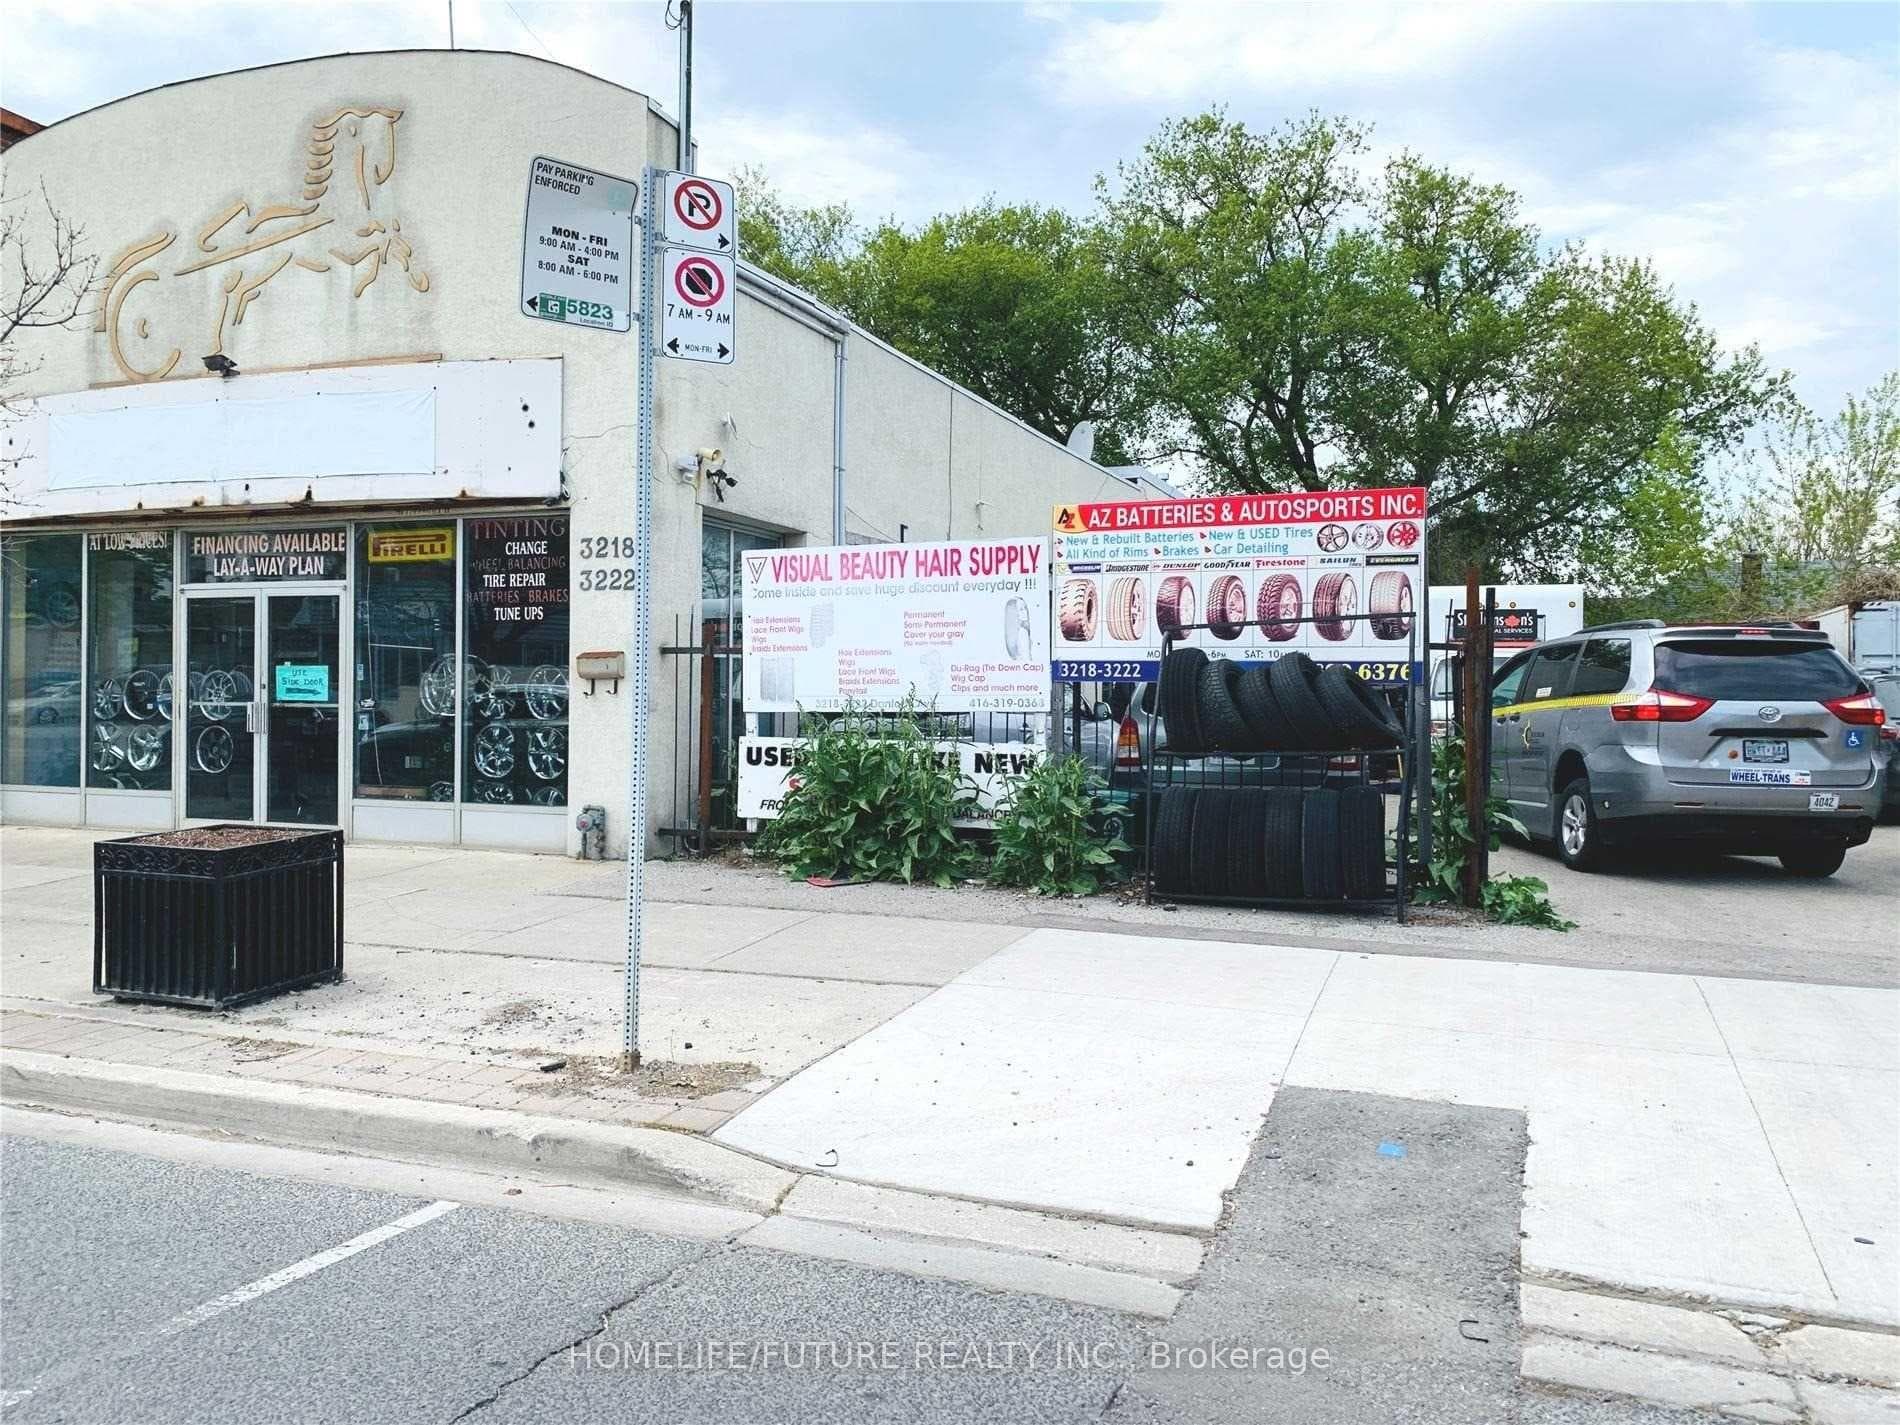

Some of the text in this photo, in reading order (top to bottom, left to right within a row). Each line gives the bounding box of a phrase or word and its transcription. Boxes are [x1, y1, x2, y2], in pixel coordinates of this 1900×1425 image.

[537, 162, 554, 174] PAY
[535, 175, 580, 195] ENFORCED
[552, 226, 579, 240] MON
[589, 235, 608, 247] FRI
[539, 236, 557, 248] 9:00
[560, 241, 576, 252] AM
[584, 246, 602, 258] 4:00
[604, 250, 619, 261] PM
[567, 254, 590, 267] SAT
[538, 260, 556, 272] 8:00
[559, 265, 575, 276] AM
[583, 270, 601, 281] 6:00
[603, 274, 618, 284] PM
[567, 299, 613, 320] 5823
[667, 304, 675, 317] 7
[678, 308, 693, 320] AM
[705, 308, 713, 321] 9
[716, 313, 730, 324] AM
[1088, 507, 1111, 528] AZ
[1116, 503, 1215, 527] BATTERIES
[1220, 502, 1233, 522] &
[1238, 495, 1374, 521] AUTOSPORTS
[1380, 493, 1423, 516] INC.
[470, 519, 565, 539] TINTING
[1208, 530, 1233, 541] New
[1250, 528, 1280, 539] USED
[1283, 526, 1313, 538] Tires
[193, 532, 345, 555] FINANCING AVAILABLE
[372, 534, 447, 557] PIRELLI
[1066, 536, 1090, 547] New
[1103, 534, 1141, 545] Rebuilt
[1144, 531, 1194, 543] Batteries
[505, 541, 548, 555] CHANGE
[580, 536, 634, 559] 3218
[1066, 547, 1149, 561] All Kind of Rims
[1162, 545, 1199, 556] Brakes
[1213, 542, 1289, 555] Car Detailing
[213, 555, 324, 577] LAY-A-WAY PLAN
[508, 555, 566, 570] BALANCING
[770, 553, 833, 583] VISUAL
[839, 550, 909, 581] BEAUTY
[915, 548, 962, 578] HAIR
[969, 544, 1041, 576] SUPPLY
[1255, 559, 1306, 569] Firestone
[482, 573, 546, 588] TIRE REPAIR
[580, 569, 635, 591] 3222
[528, 588, 568, 602] BRAKES
[820, 585, 840, 596] and
[845, 585, 871, 596] save
[875, 582, 905, 597] huge
[908, 581, 959, 594] discount
[963, 579, 1021, 593] everyday
[494, 606, 544, 621] TUNE UPS
[928, 631, 945, 639] your
[1244, 650, 1264, 659] SAT:
[998, 663, 1021, 672] Down
[1023, 663, 1044, 672] Cap)
[1060, 663, 1142, 678] 3218-3222
[968, 673, 986, 683] Cap
[973, 683, 989, 692] and
[991, 683, 1015, 692] much
[1017, 684, 1039, 692] more
[974, 752, 1036, 775] NEW
[1731, 772, 1791, 784] WHEEL-TRANS
[1814, 797, 1835, 808] 4042
